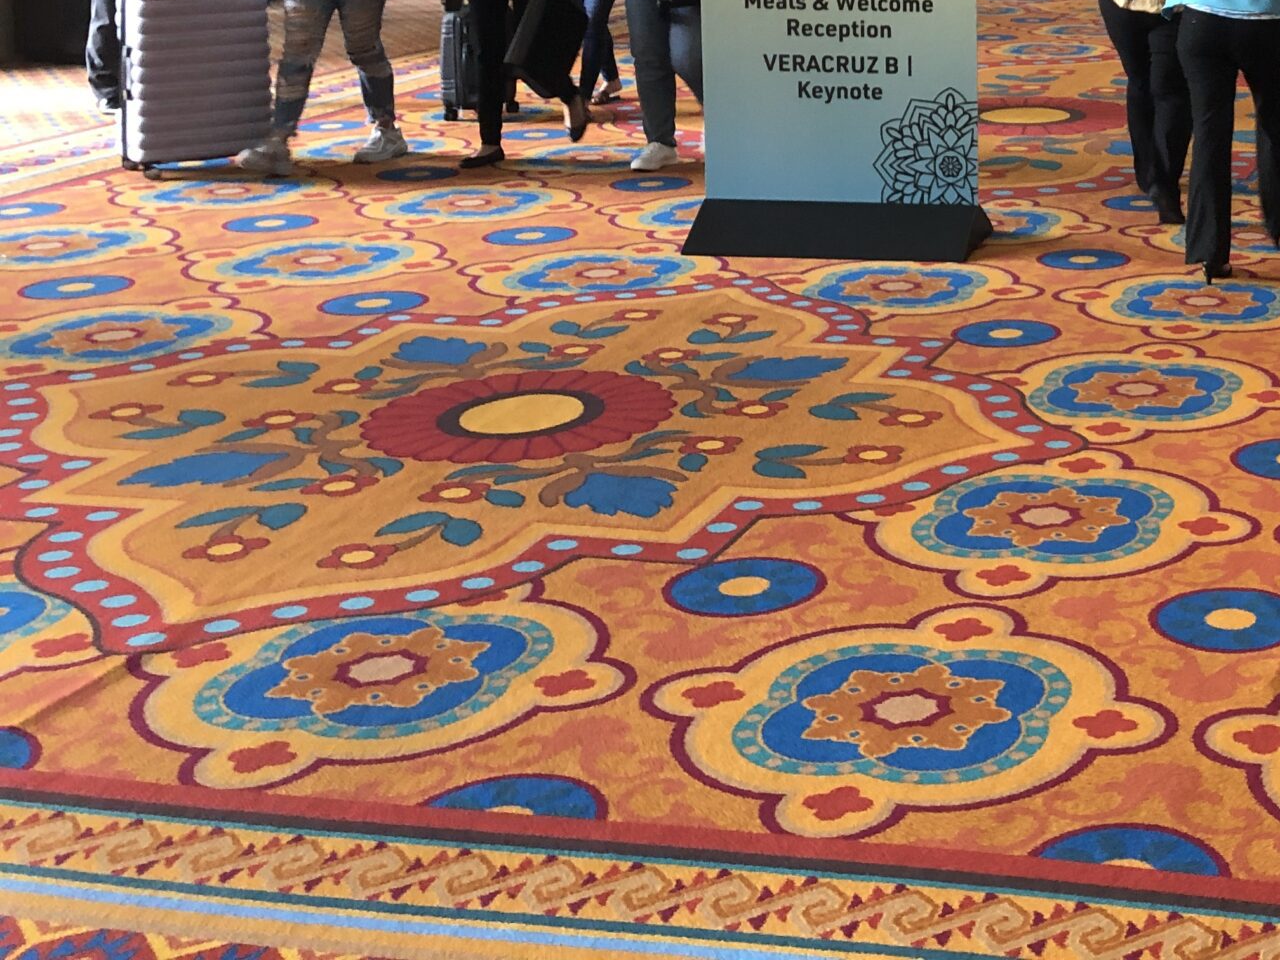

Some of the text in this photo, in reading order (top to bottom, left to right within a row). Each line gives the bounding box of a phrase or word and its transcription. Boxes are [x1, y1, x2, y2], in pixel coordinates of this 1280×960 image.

[787, 19, 892, 42] Reception
[763, 55, 879, 73] VERACRUZ
[885, 57, 898, 74] B
[798, 81, 883, 103] Keynote
